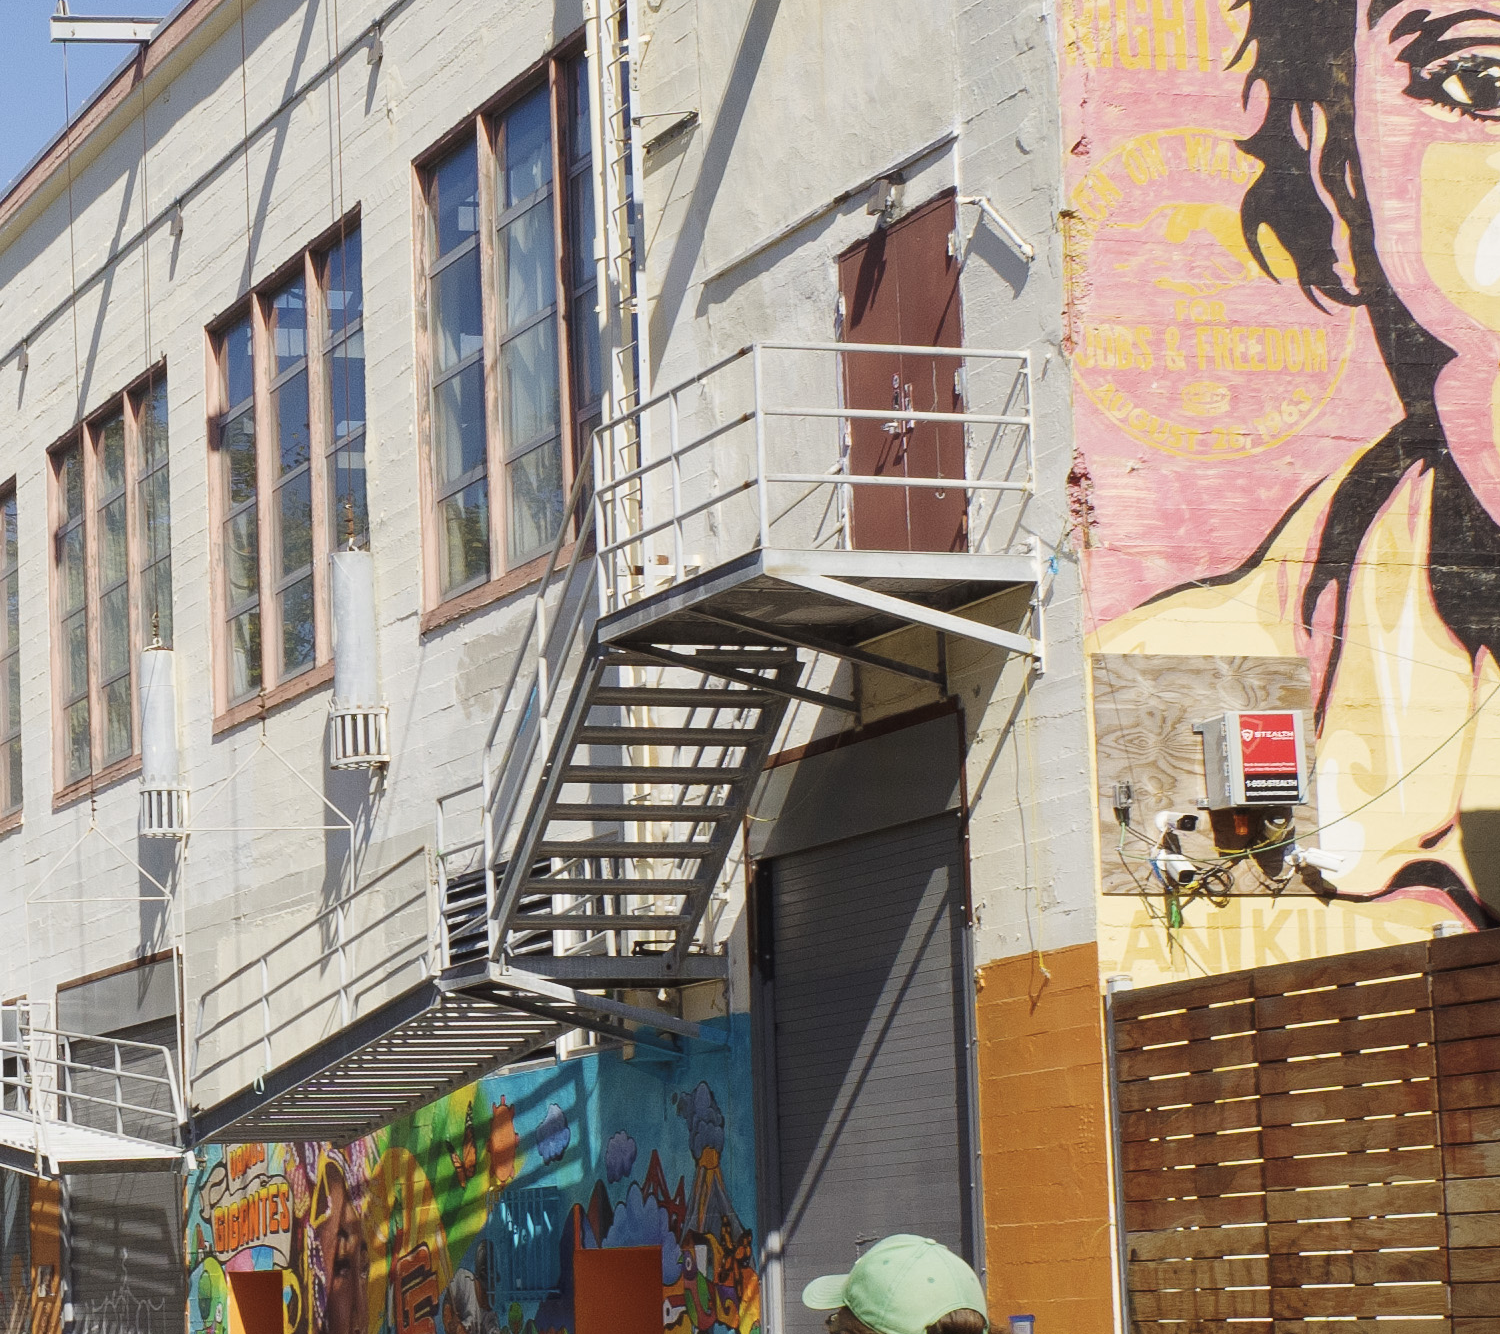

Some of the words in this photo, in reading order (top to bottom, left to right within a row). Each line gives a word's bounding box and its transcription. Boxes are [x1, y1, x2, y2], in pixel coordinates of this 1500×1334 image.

[1121, 135, 1168, 185] ON
[1175, 299, 1227, 323] FOR
[1075, 324, 1153, 371] JOBS
[1164, 326, 1187, 371] &
[1196, 326, 1328, 372] FREEDOM
[1093, 383, 1200, 450] AUGUST
[1254, 387, 1312, 441] 1963
[214, 1183, 290, 1255] GIGANTES
